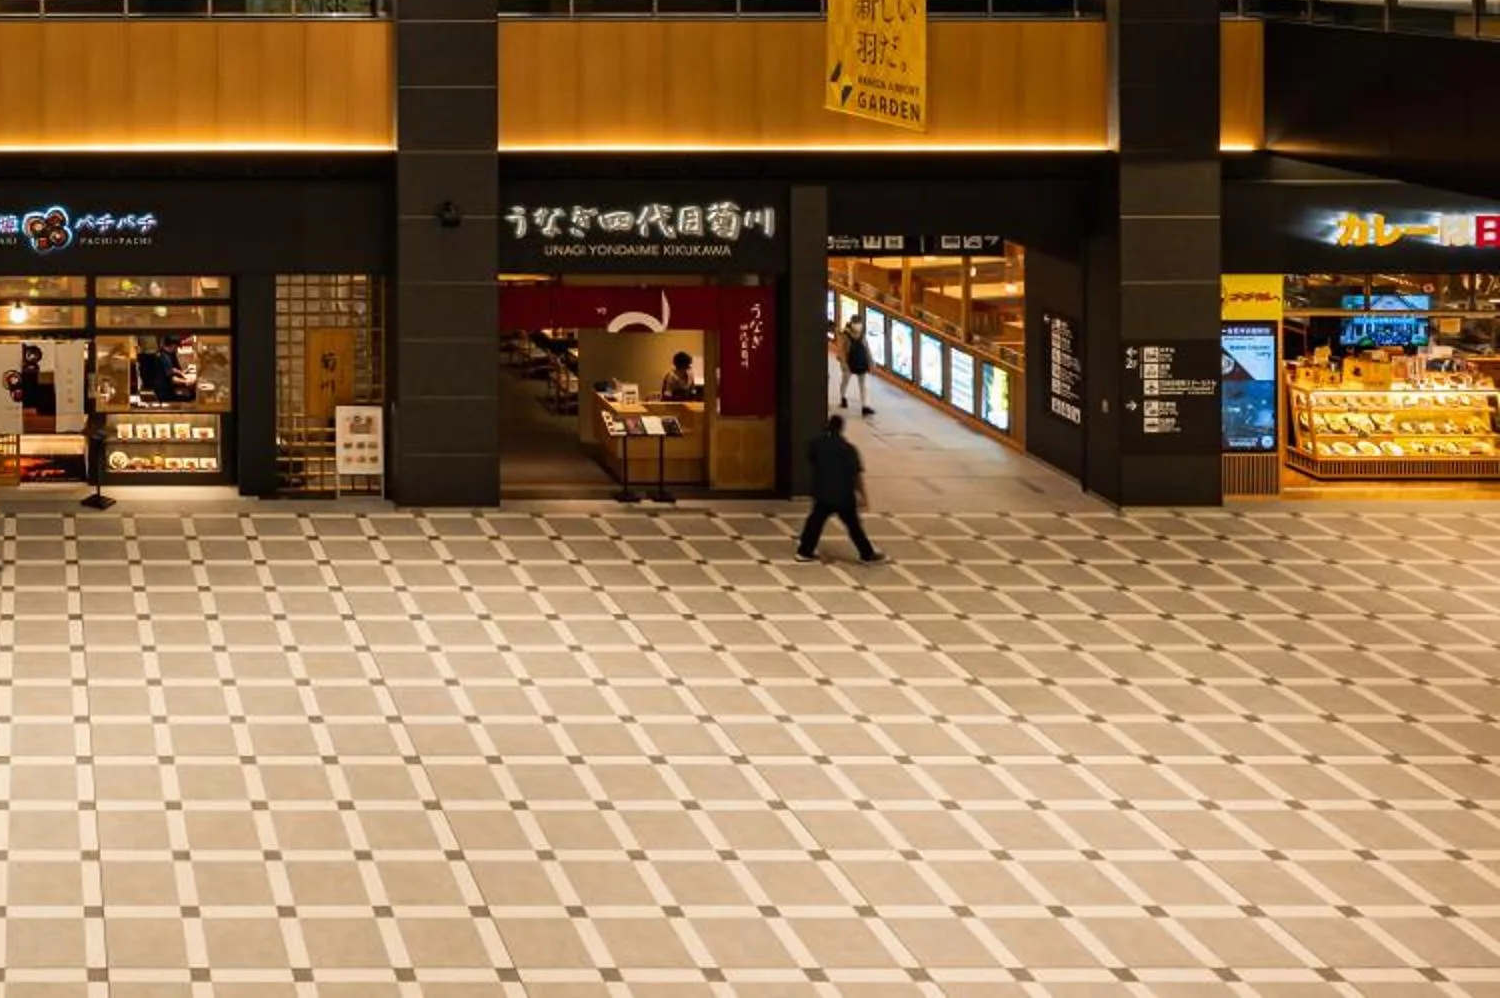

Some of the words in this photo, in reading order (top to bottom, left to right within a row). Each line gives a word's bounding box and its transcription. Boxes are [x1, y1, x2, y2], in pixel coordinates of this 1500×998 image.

[856, 31, 907, 74] 羽だ。
[857, 91, 921, 122] GARDEN
[75, 213, 158, 235] パチパチ
[544, 244, 586, 257] UNAGI
[588, 244, 660, 257] YONDAIME
[663, 244, 732, 257] KIKUKAWA
